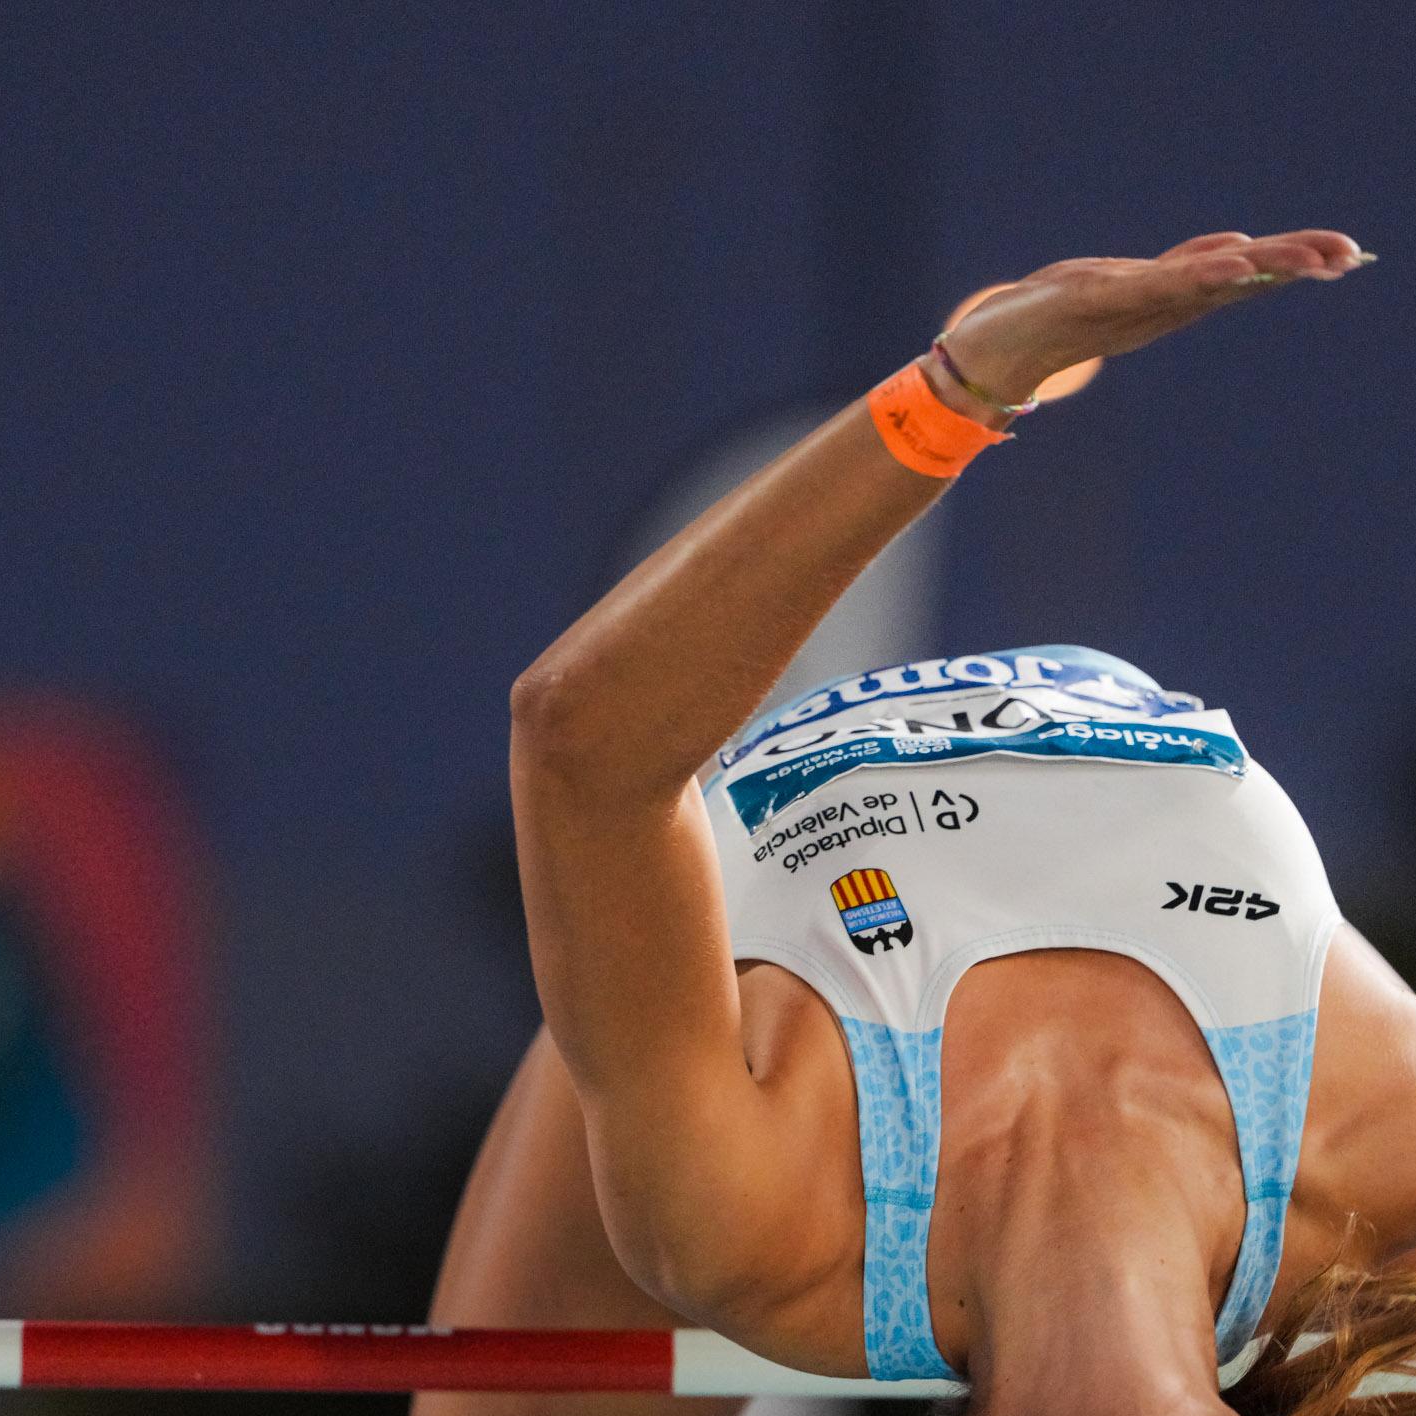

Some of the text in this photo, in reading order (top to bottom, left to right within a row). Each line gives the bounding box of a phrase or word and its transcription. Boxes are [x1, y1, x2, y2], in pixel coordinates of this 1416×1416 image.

[753, 792, 898, 863] de València
[783, 815, 908, 874] Diputació
[1160, 881, 1281, 921] 42K
